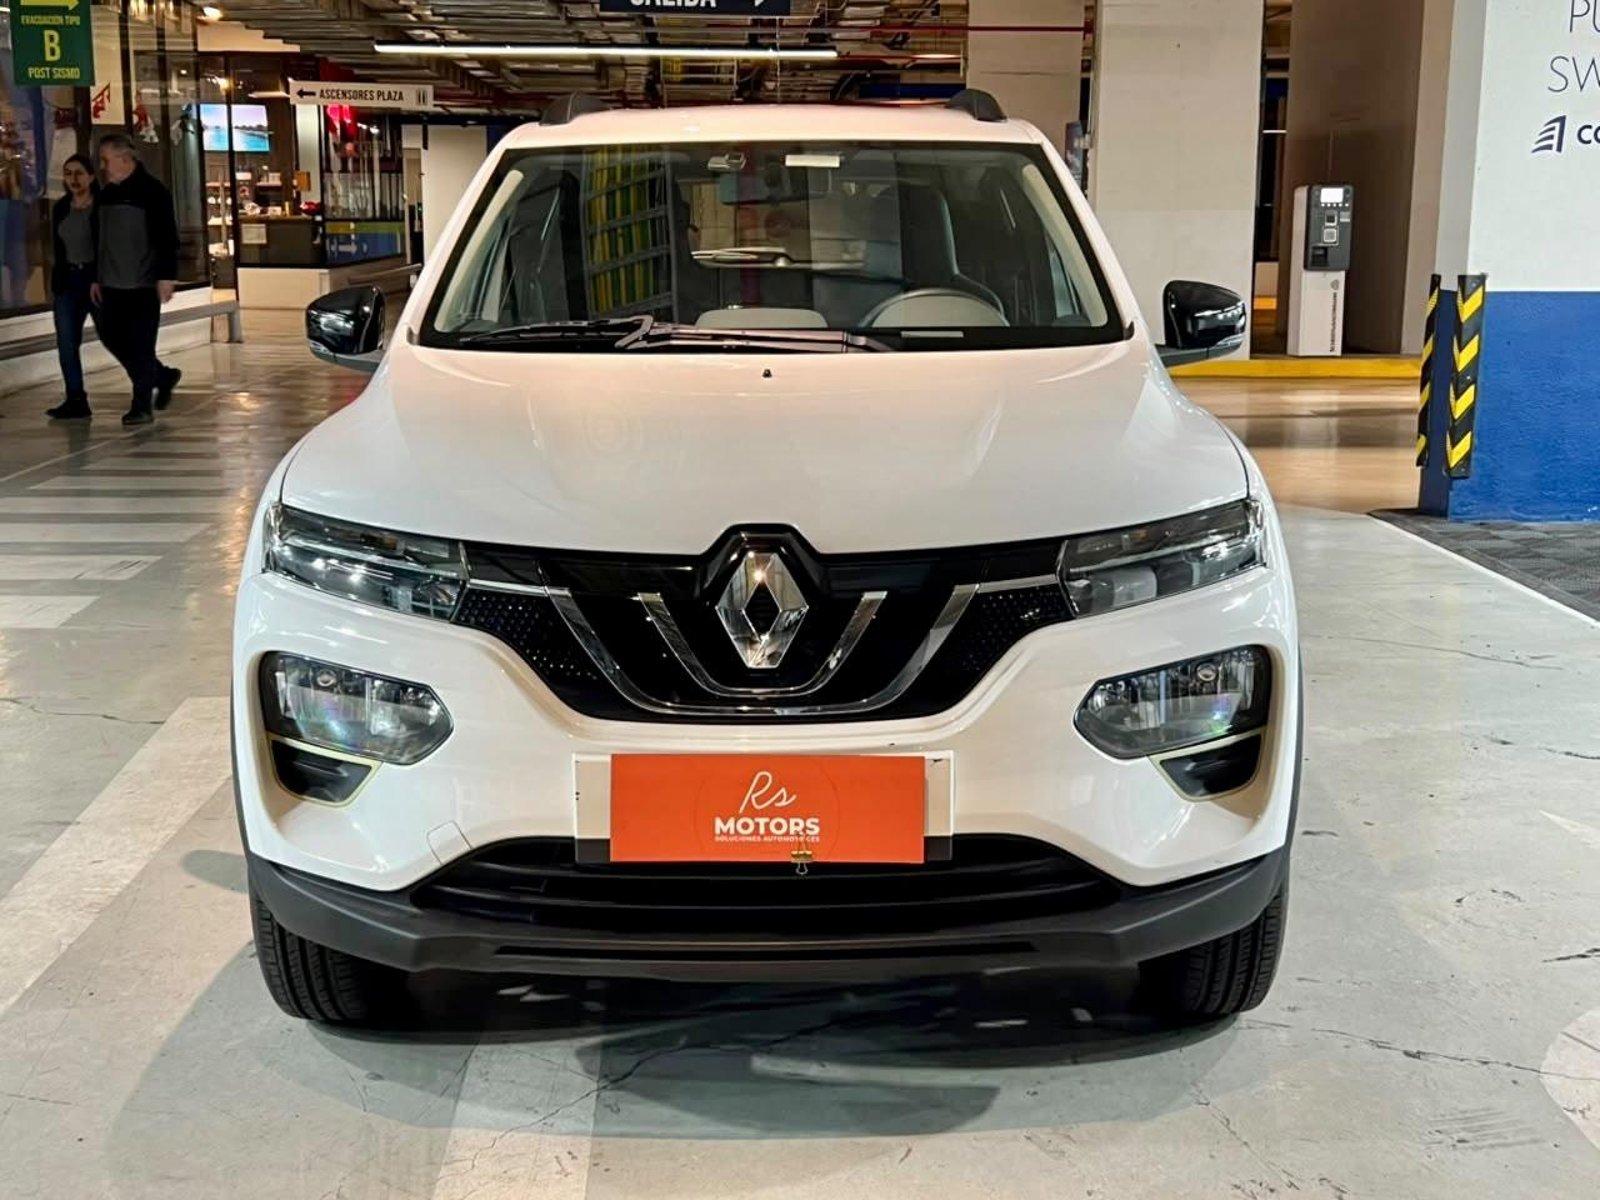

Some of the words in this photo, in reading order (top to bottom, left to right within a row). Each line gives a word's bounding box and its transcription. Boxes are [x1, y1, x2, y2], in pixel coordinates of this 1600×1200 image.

[43, 29, 61, 61] B
[28, 67, 50, 79] POST
[52, 67, 80, 79] SISMO
[319, 88, 375, 101] ASCENSORES
[376, 90, 404, 102] PLAZA
[739, 770, 797, 814] Rs
[714, 816, 820, 835] MOTORS
